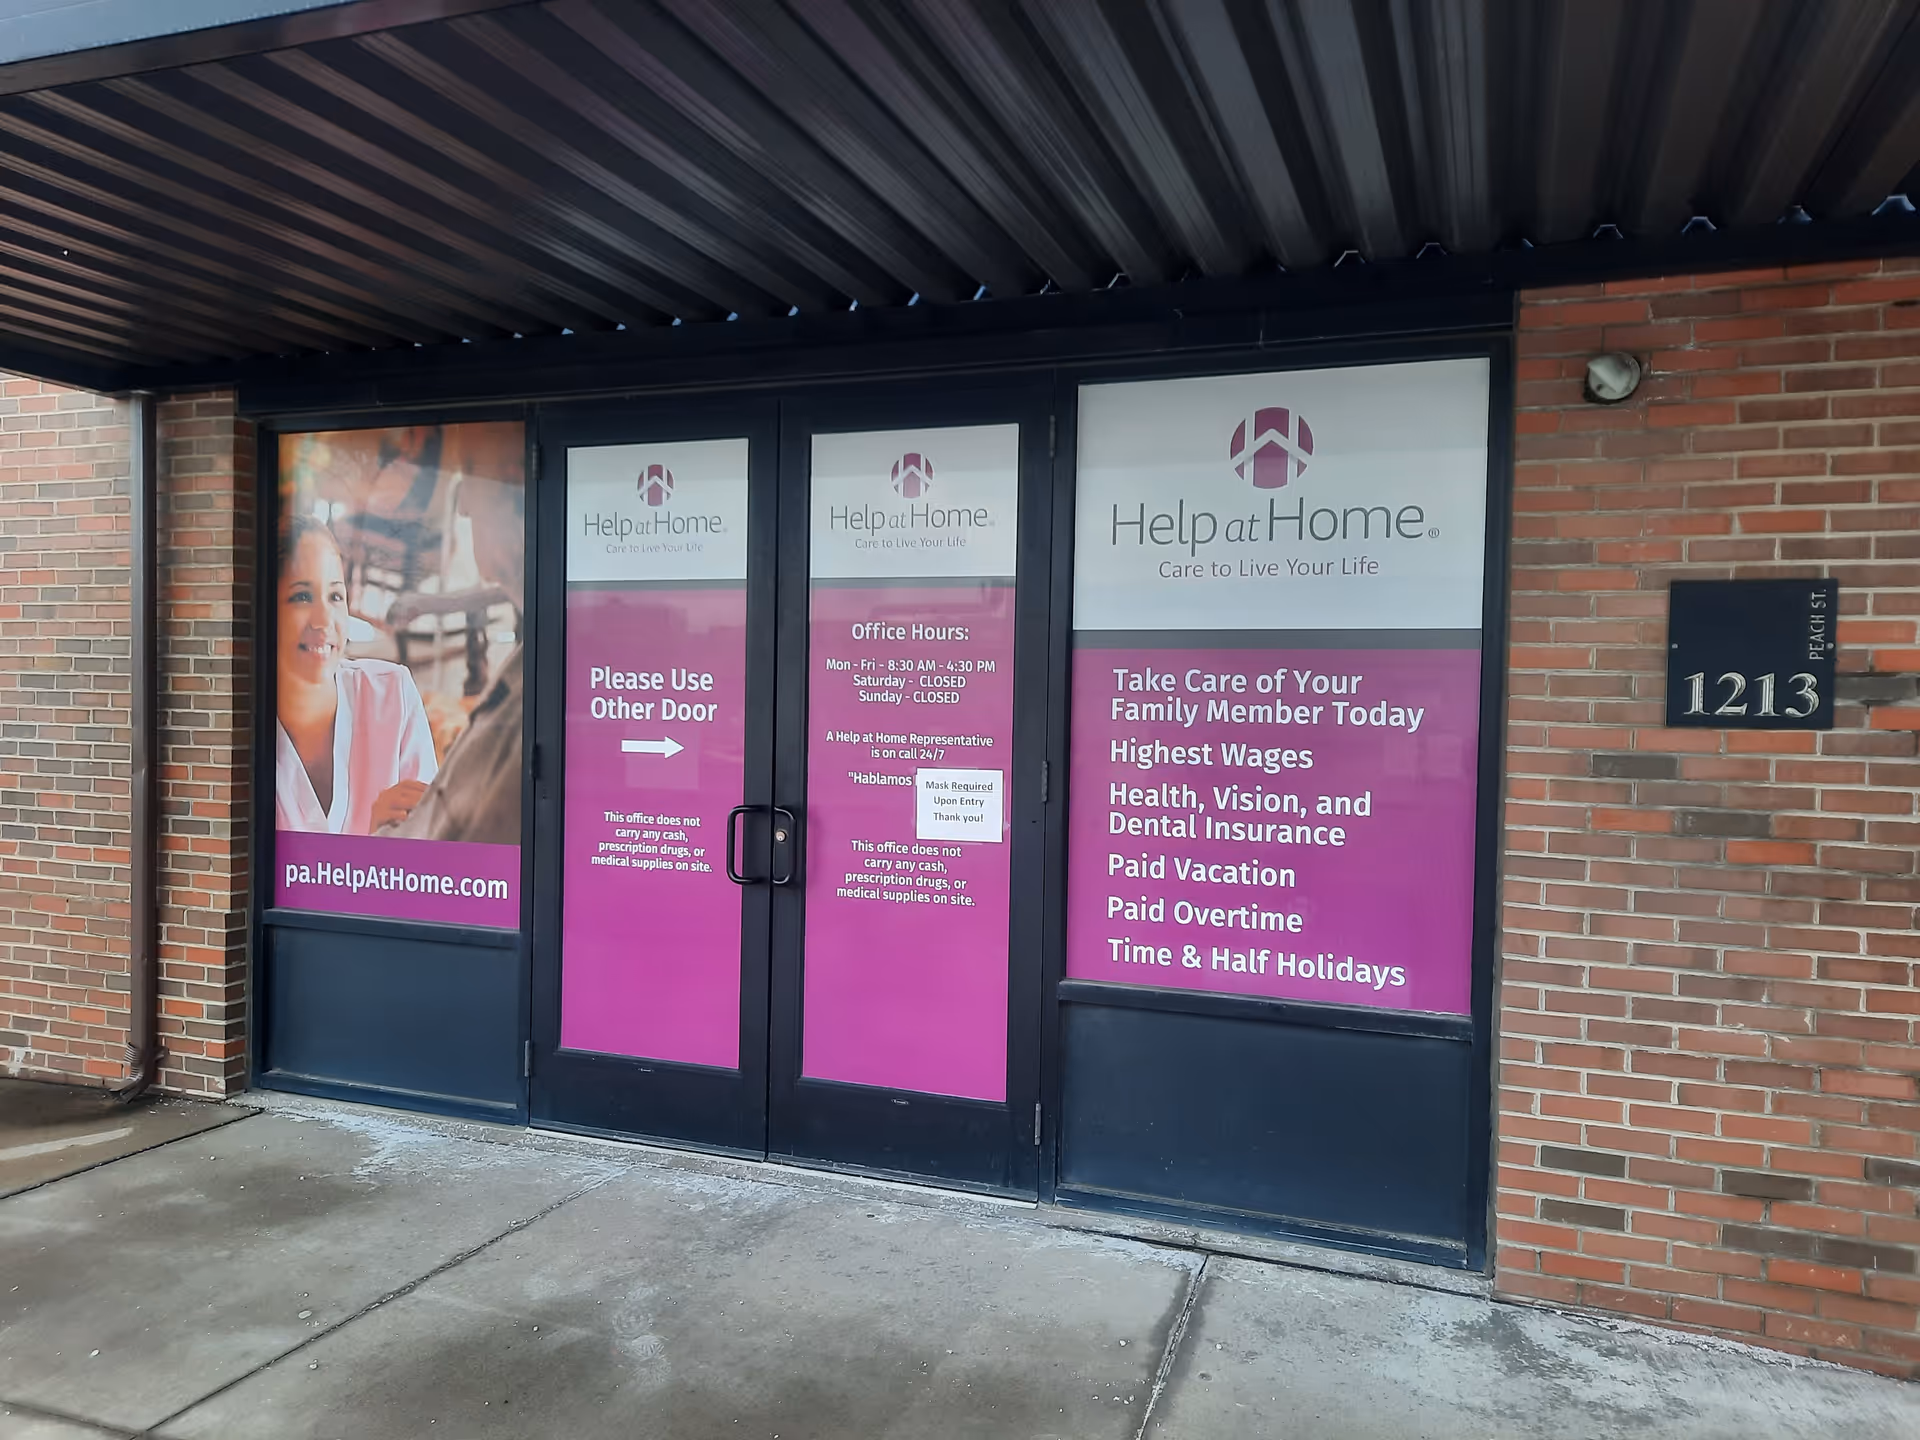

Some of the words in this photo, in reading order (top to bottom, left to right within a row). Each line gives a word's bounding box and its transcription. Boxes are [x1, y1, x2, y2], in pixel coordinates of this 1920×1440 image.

[584, 512, 633, 542] Help
[636, 520, 651, 535] at
[830, 504, 885, 536] Help
[889, 512, 906, 529] at
[1112, 498, 1218, 557] Help
[1225, 513, 1260, 543] at
[606, 544, 627, 553] Care
[629, 544, 639, 553] to
[642, 543, 660, 552] Live
[662, 543, 683, 552] Your
[686, 543, 703, 552] Life
[855, 539, 878, 549] Care
[882, 538, 893, 548] to
[896, 538, 917, 548] Live
[919, 537, 943, 547] Your
[947, 536, 966, 547] Life
[1158, 560, 1204, 578] Care
[1210, 560, 1232, 577] to
[1239, 558, 1279, 577] Live
[1286, 558, 1334, 576] Your
[1341, 555, 1379, 575] Life
[1811, 589, 1827, 608] ST.
[852, 622, 906, 640] Office
[911, 624, 970, 641] Hours:
[1809, 615, 1825, 660] PEACH
[826, 658, 851, 670] Mon
[861, 658, 875, 671] Fri
[888, 660, 914, 672] 8:30
[917, 660, 936, 672] AM
[947, 660, 973, 672] 4:30
[977, 661, 996, 673] PM
[590, 666, 664, 690] Please
[671, 668, 714, 691] Use
[853, 674, 906, 689] Saturday
[920, 675, 966, 688] CLOSED
[1113, 667, 1176, 693] Take
[1184, 668, 1247, 693] Care
[1256, 668, 1288, 693] of
[1293, 669, 1363, 694] Your
[859, 690, 902, 705] Sunday
[913, 691, 960, 704] CLOSED
[1683, 672, 1820, 717] 1213
[590, 696, 655, 720] Other
[662, 698, 718, 721] Door
[1111, 696, 1199, 728] Family
[1206, 699, 1324, 725] Member
[1332, 700, 1424, 733] Today
[826, 731, 833, 742] A
[836, 731, 860, 744] Help
[862, 733, 873, 743] at
[876, 733, 907, 744] Home
[910, 734, 993, 747] Representative
[871, 746, 879, 758] is
[883, 749, 896, 759] on
[899, 748, 917, 759] call
[920, 749, 944, 760] 24/7
[1110, 737, 1213, 769] Highest
[1221, 742, 1314, 774] Wages
[925, 781, 949, 790] Mask
[952, 782, 993, 792] Required
[934, 796, 957, 806] Upon
[960, 797, 984, 808] Entry
[1109, 782, 1205, 815] Health,
[1213, 785, 1307, 819] Vision,
[1316, 791, 1372, 817] and
[604, 811, 624, 823] This
[626, 812, 654, 825] office
[657, 814, 681, 826] does
[683, 816, 700, 827] not
[933, 812, 960, 822] Thank
[963, 814, 984, 824] you!
[615, 828, 640, 840] carry
[643, 830, 660, 842] any
[663, 830, 689, 843] cash,
[1108, 811, 1196, 839] Dental
[1205, 816, 1346, 846] Insurance
[599, 842, 658, 854] prescription
[660, 844, 691, 858] drugs,
[694, 847, 705, 857] or
[852, 840, 874, 852] This
[877, 841, 909, 854] office
[912, 844, 939, 856] does
[942, 846, 961, 857] not
[591, 855, 630, 867] medical
[631, 858, 673, 871] supplies
[676, 861, 688, 871] on
[691, 861, 712, 872] site.
[864, 858, 892, 871] carry
[896, 860, 915, 872] any
[918, 861, 947, 874] cash,
[1108, 852, 1166, 880] Paid
[1173, 856, 1296, 887] Vacation
[285, 862, 508, 900] pa.HelpAtHome.com
[845, 872, 912, 886] prescription
[916, 875, 951, 890] drugs,
[954, 879, 967, 889] or
[837, 887, 880, 899] medical
[882, 890, 930, 903] supplies
[933, 893, 947, 904] on
[950, 894, 975, 906] site.
[1107, 895, 1165, 923] Paid
[1173, 901, 1303, 933] Overtime
[1108, 937, 1172, 966] Time
[1181, 944, 1202, 969] &
[1211, 946, 1271, 974] Half
[1277, 952, 1406, 990] Holidays
